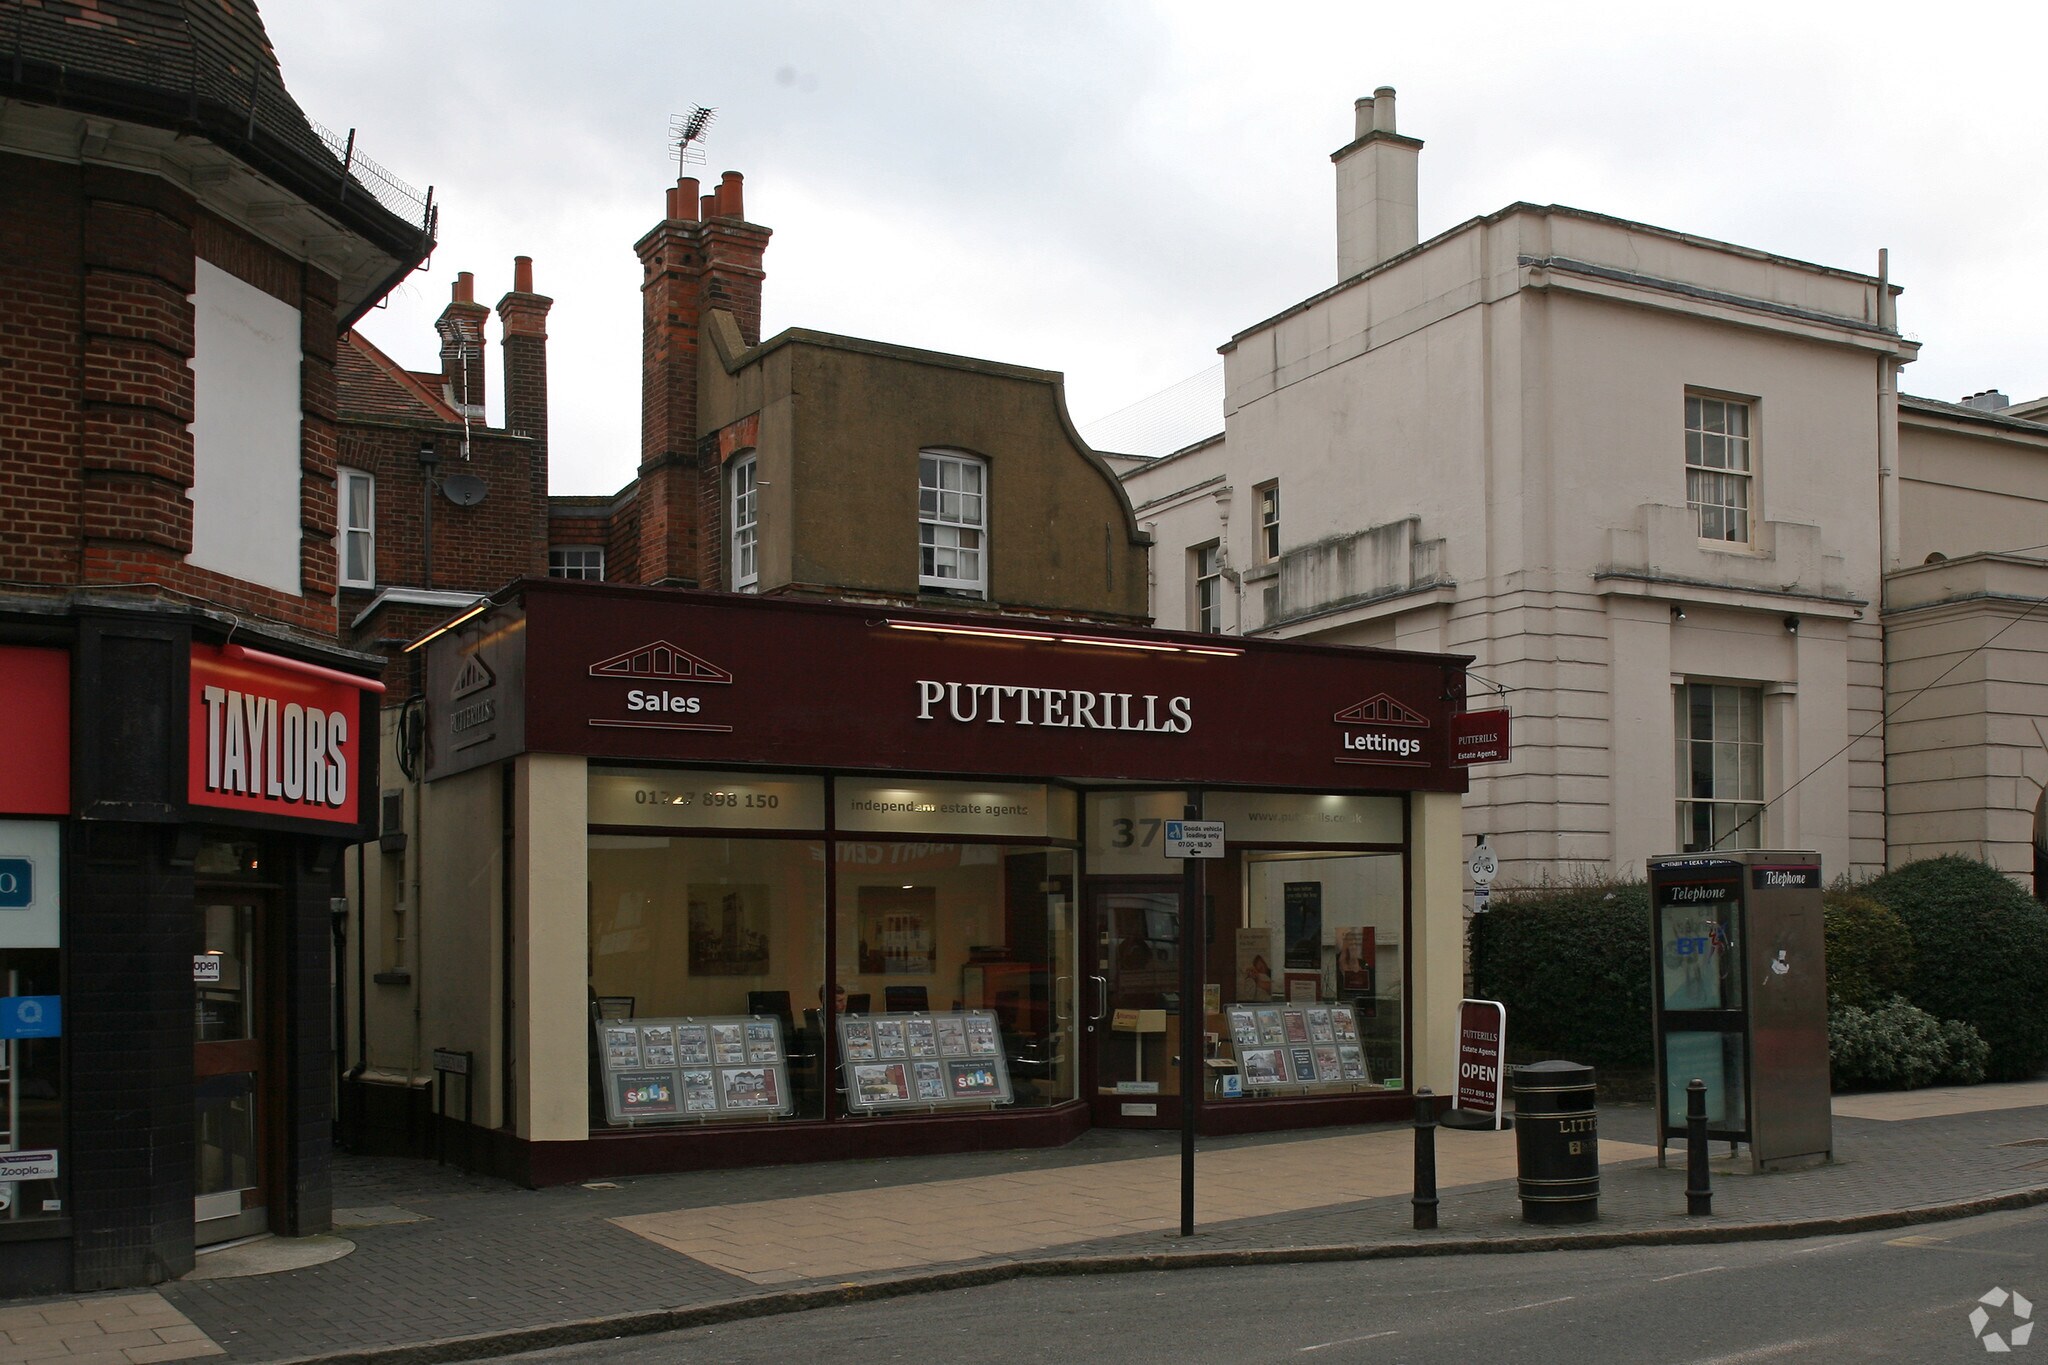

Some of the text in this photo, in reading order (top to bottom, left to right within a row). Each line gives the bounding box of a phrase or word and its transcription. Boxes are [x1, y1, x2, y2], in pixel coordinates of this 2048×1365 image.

[627, 690, 701, 714] Sales
[916, 680, 1192, 734] PUTTERILLS
[450, 698, 491, 734] PUTTERILLS
[204, 684, 348, 806] TAYLORS
[1344, 732, 1421, 756] Lettings
[1458, 732, 1498, 745] PUTTERILLS
[1457, 750, 1497, 760] Estate Agents
[703, 791, 738, 807] 898
[745, 794, 779, 808] 150
[941, 802, 981, 814] estate
[986, 804, 1028, 816] agents
[1111, 817, 1161, 850] 37
[1766, 871, 1806, 887] Telephone
[1671, 886, 1726, 902] Telephone
[1677, 937, 1708, 955] BT
[194, 961, 218, 972] open
[1463, 1029, 1498, 1042] PUTTERILLS
[1462, 1045, 1497, 1057] Estate Agents
[1461, 1062, 1496, 1082] OPEN
[958, 1073, 993, 1088] SOLD
[627, 1088, 668, 1103] SOLD
